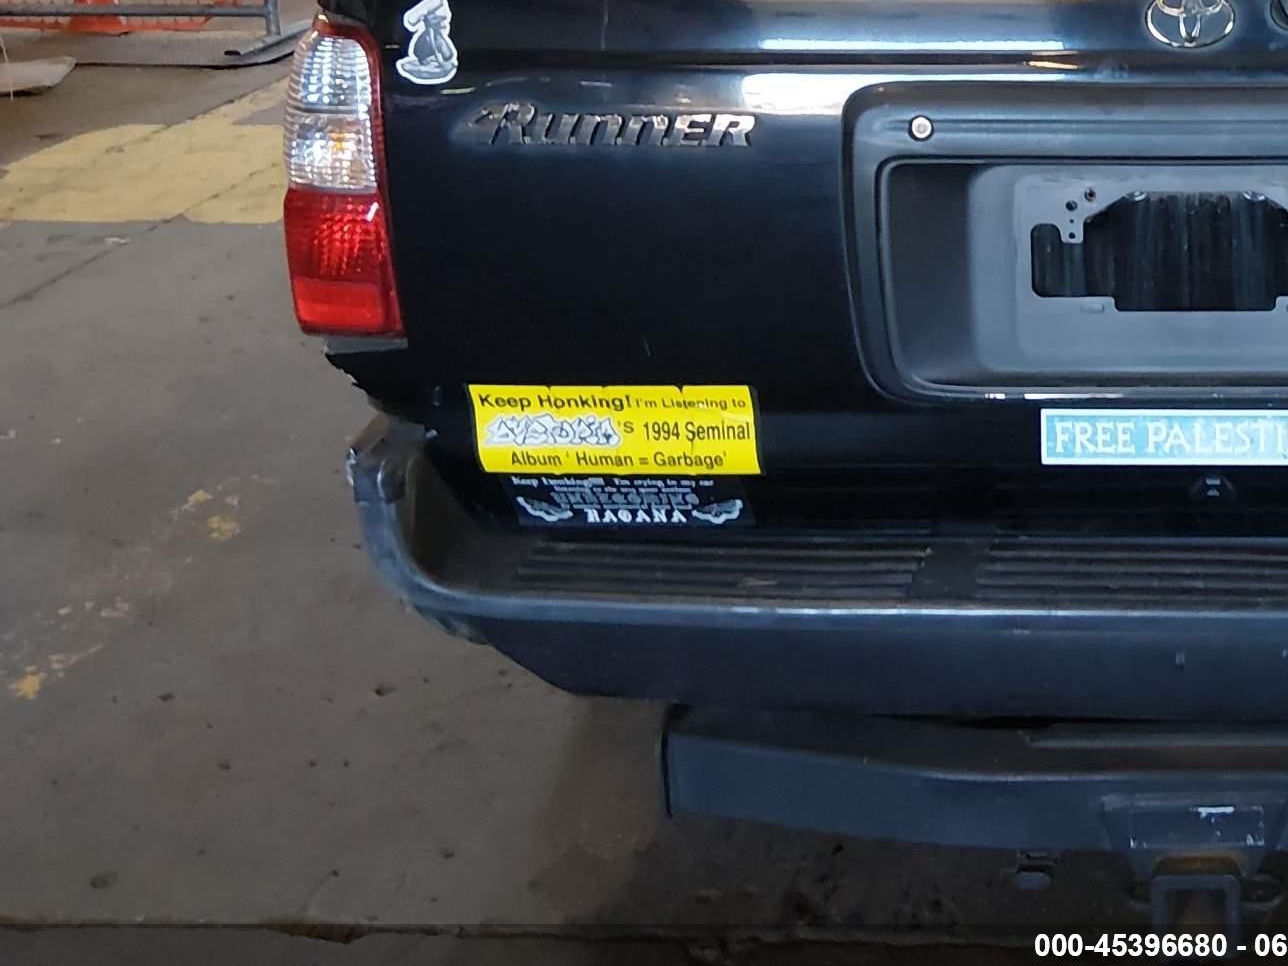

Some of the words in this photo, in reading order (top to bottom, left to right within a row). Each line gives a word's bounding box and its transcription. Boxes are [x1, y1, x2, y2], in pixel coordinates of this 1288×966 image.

[478, 393, 532, 411] Keep
[539, 393, 631, 412] Honking!
[635, 397, 658, 409] I'm
[662, 397, 729, 411] Listening
[732, 397, 747, 409] to
[642, 421, 680, 442] 1994
[685, 419, 751, 442] Seminal
[1054, 420, 1135, 454] FREE
[511, 451, 562, 467] Album
